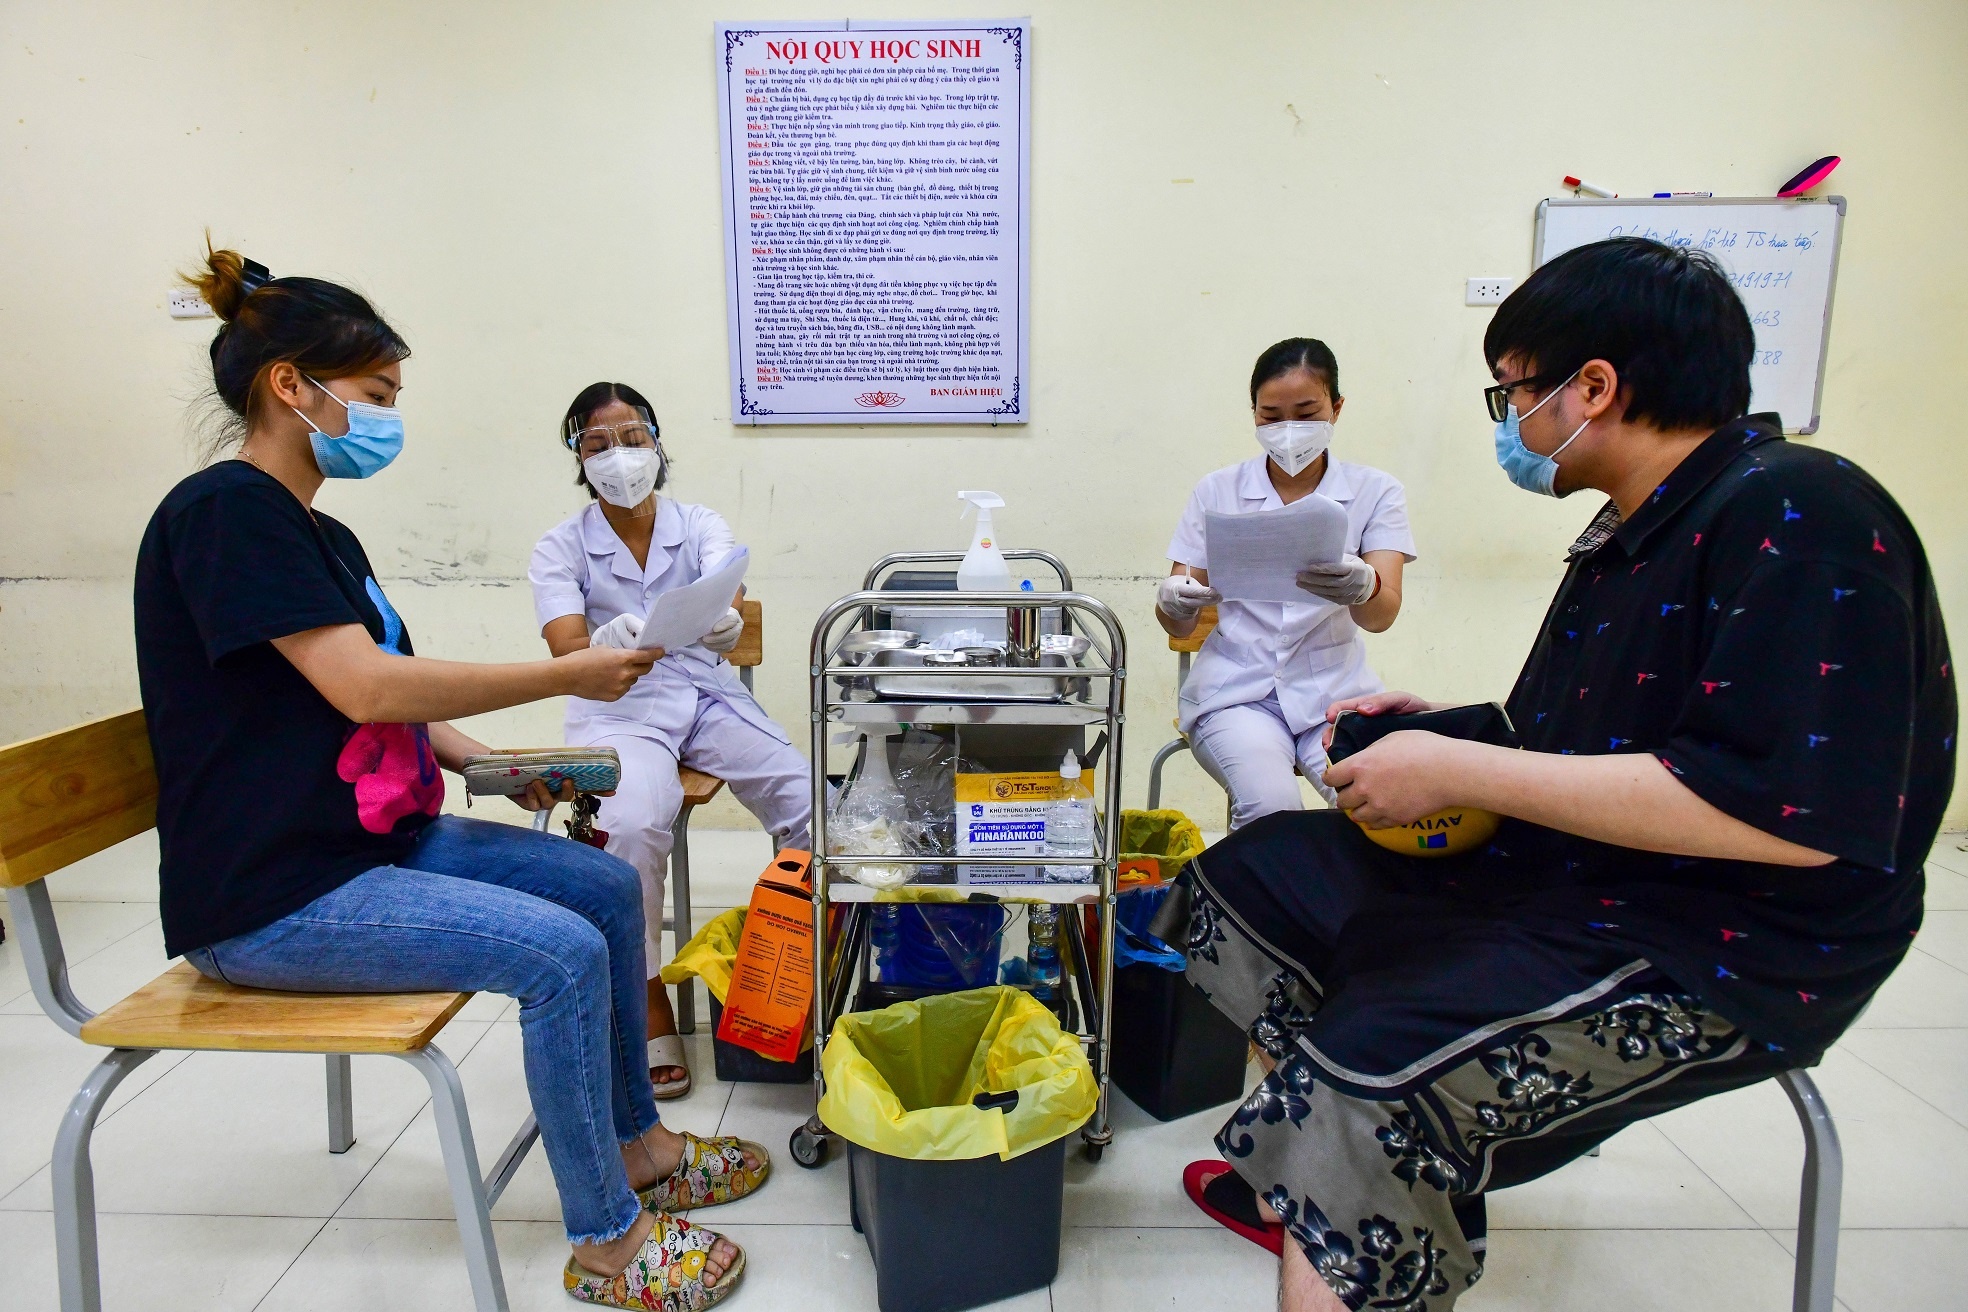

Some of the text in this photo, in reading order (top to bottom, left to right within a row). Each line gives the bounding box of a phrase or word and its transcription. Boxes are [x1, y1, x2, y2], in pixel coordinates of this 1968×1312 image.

[766, 38, 981, 65] NỘI QUY HỌC SINH
[1746, 231, 1766, 248] TS
[930, 386, 1003, 398] BAN GIÁM HIỆU
